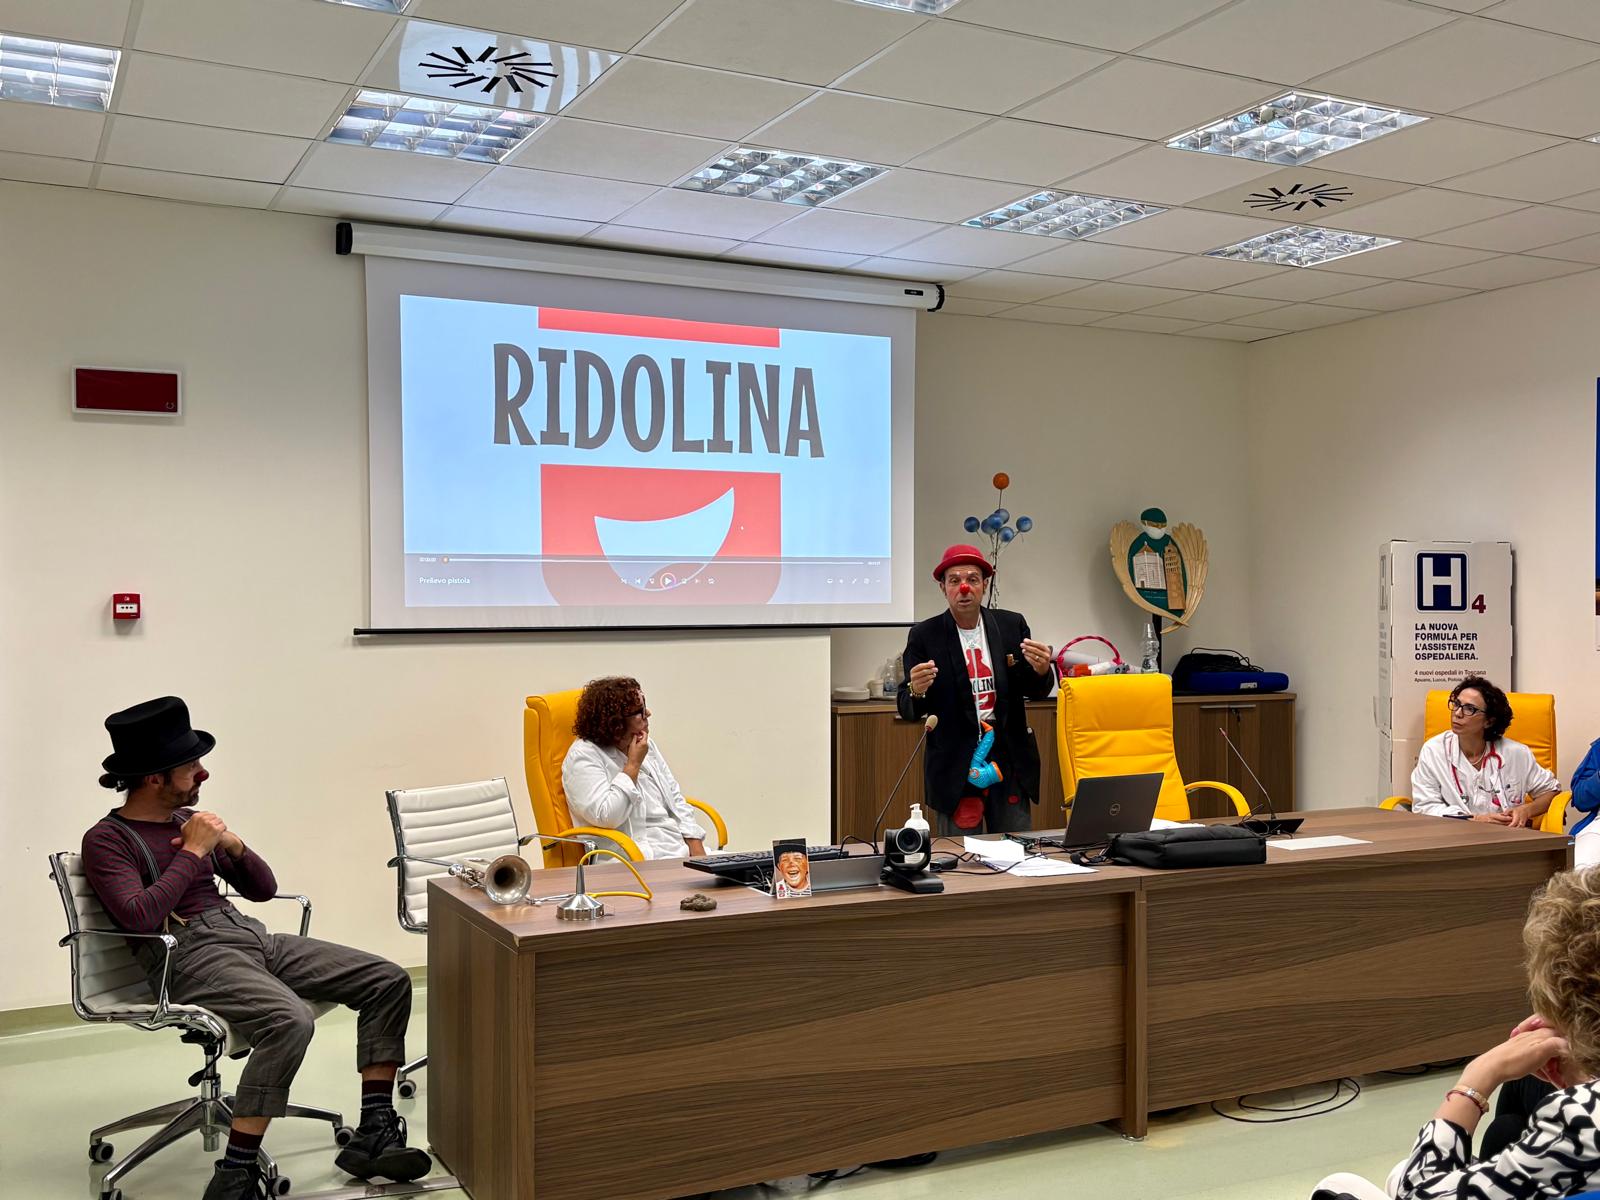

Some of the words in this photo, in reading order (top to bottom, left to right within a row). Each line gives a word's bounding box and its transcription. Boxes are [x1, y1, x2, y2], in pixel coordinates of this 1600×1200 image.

[493, 342, 825, 458] RIDOLINA
[1422, 557, 1462, 606] H
[1471, 594, 1486, 613] 4
[1415, 623, 1426, 631] LA
[1428, 623, 1458, 631] NUOVA
